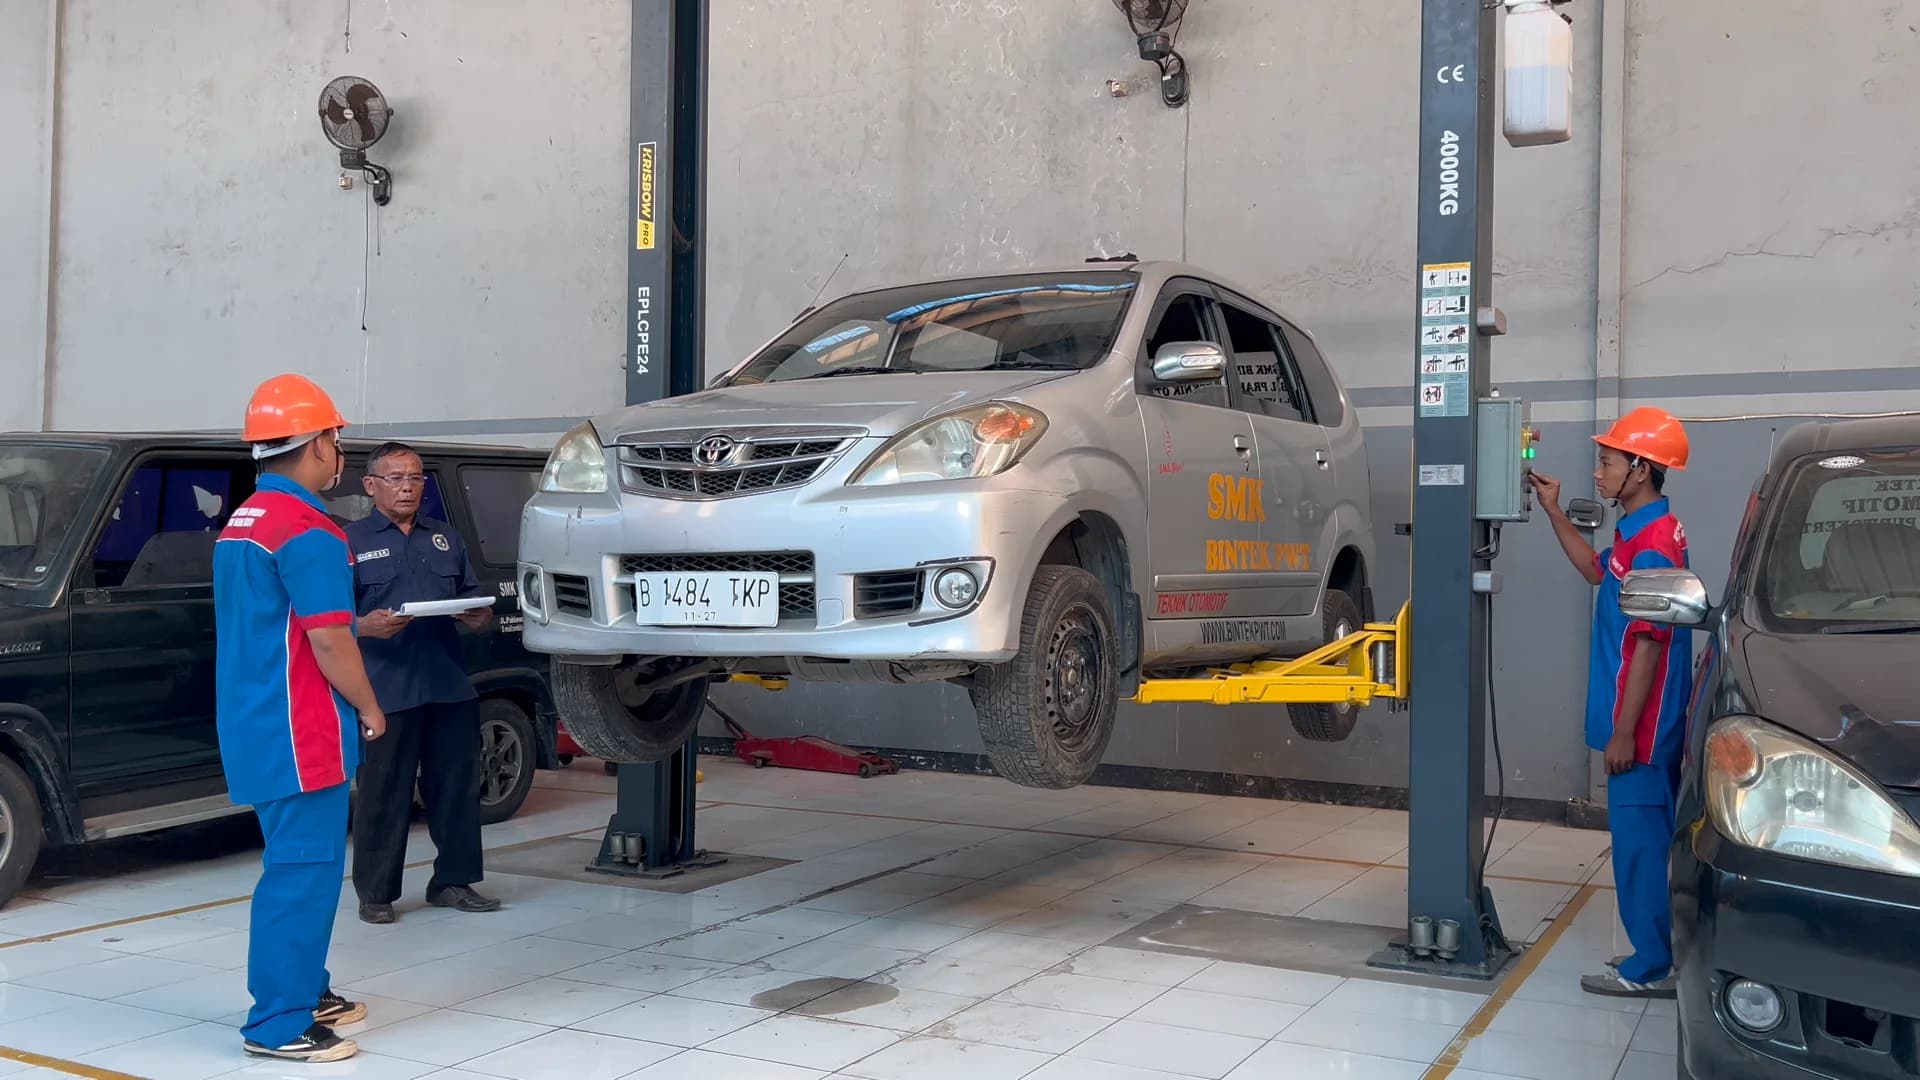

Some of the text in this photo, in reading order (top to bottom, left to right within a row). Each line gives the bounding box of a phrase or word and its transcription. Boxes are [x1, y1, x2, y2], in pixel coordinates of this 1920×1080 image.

[1437, 64, 1465, 84] CE
[1439, 130, 1460, 216] 4000KG
[641, 147, 653, 246] KRISBOW PRO
[637, 286, 650, 375] EPLCPE24
[1207, 472, 1266, 522] SMK
[1206, 539, 1311, 571] BINTEK PWT
[499, 581, 517, 597] SMK
[639, 577, 770, 608] B 1484 TKP
[1156, 592, 1229, 614] TEKNIK OTOMOTIF
[684, 611, 716, 622] 11-27
[1200, 620, 1287, 645] WWW.BINTEKPWT.COM
